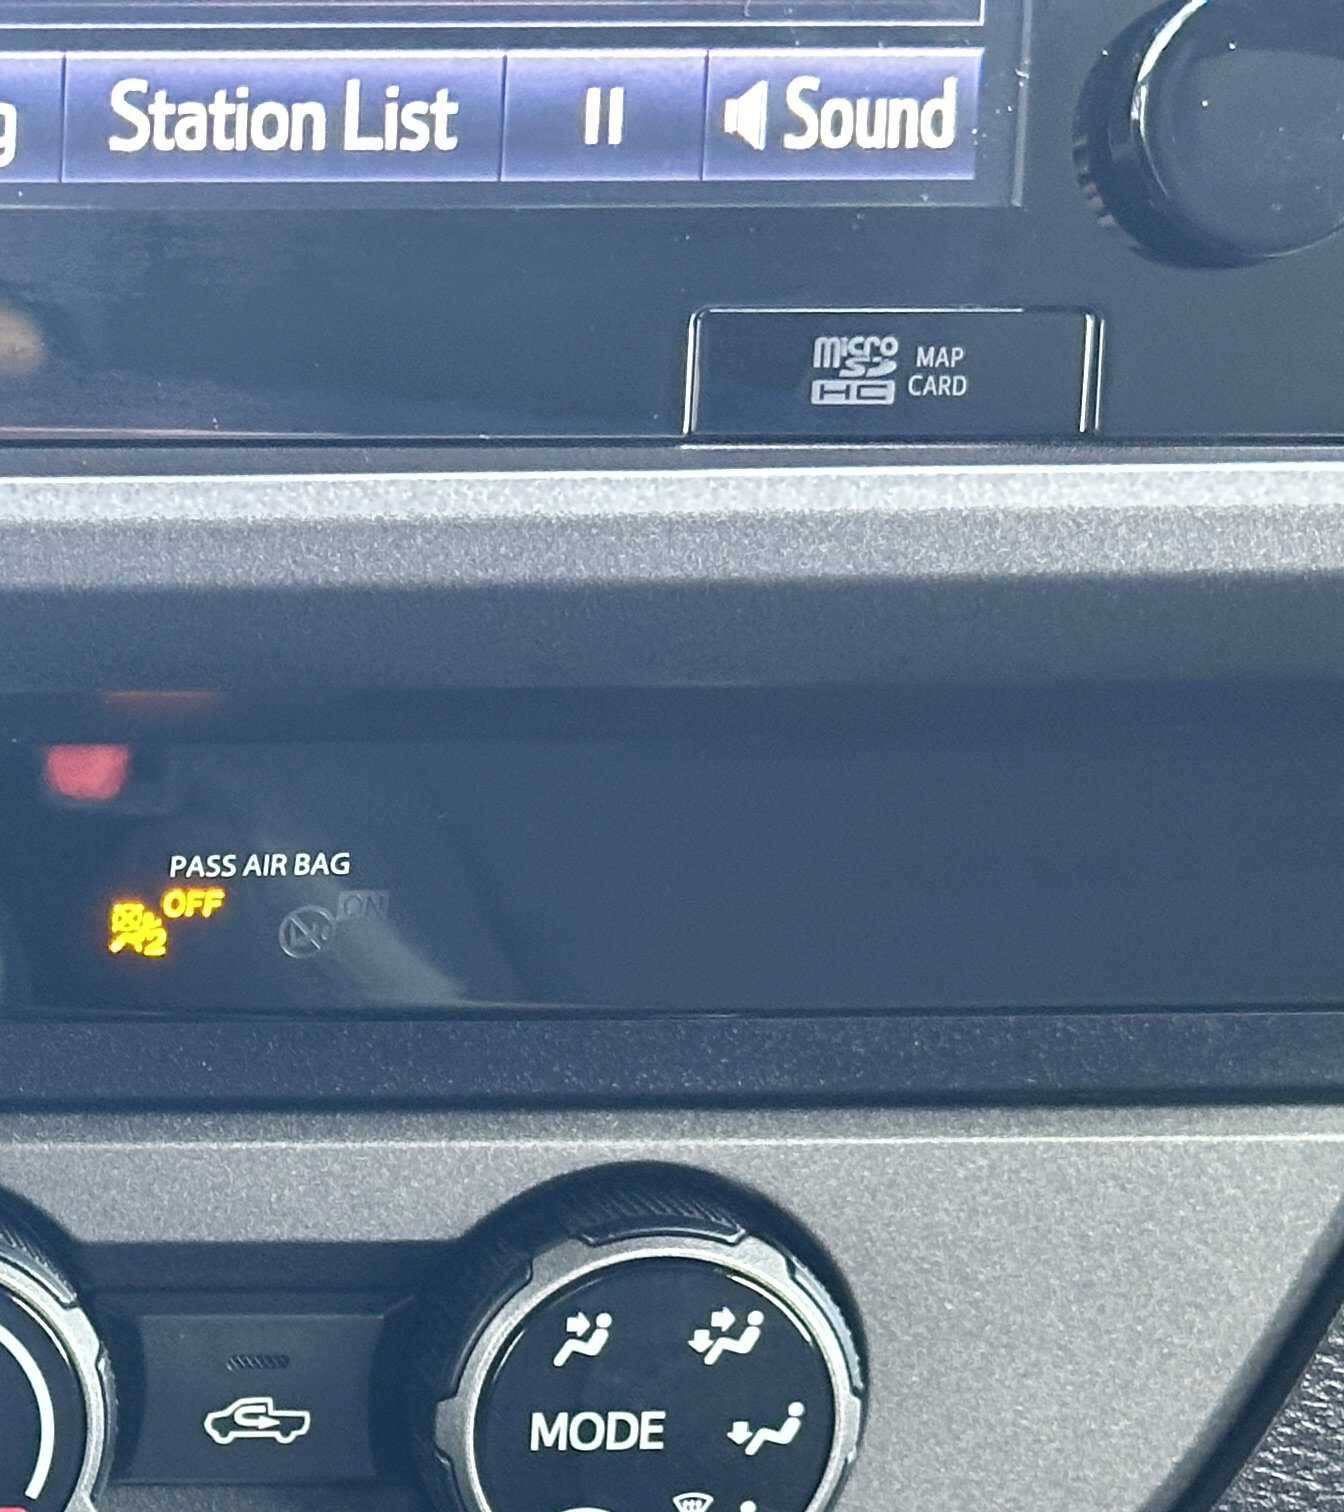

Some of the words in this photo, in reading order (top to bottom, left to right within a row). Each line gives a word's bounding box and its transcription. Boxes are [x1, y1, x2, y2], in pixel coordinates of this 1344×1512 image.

[108, 78, 326, 153] Station
[343, 78, 459, 152] List
[781, 77, 957, 151] Sound
[916, 346, 964, 368] MAP
[810, 379, 896, 405] HC
[908, 374, 968, 396] CARD
[169, 854, 237, 878] PASS
[242, 853, 288, 877] AIR
[293, 852, 351, 876] BAG
[162, 887, 226, 919] OFF
[530, 1410, 666, 1451] MODE
